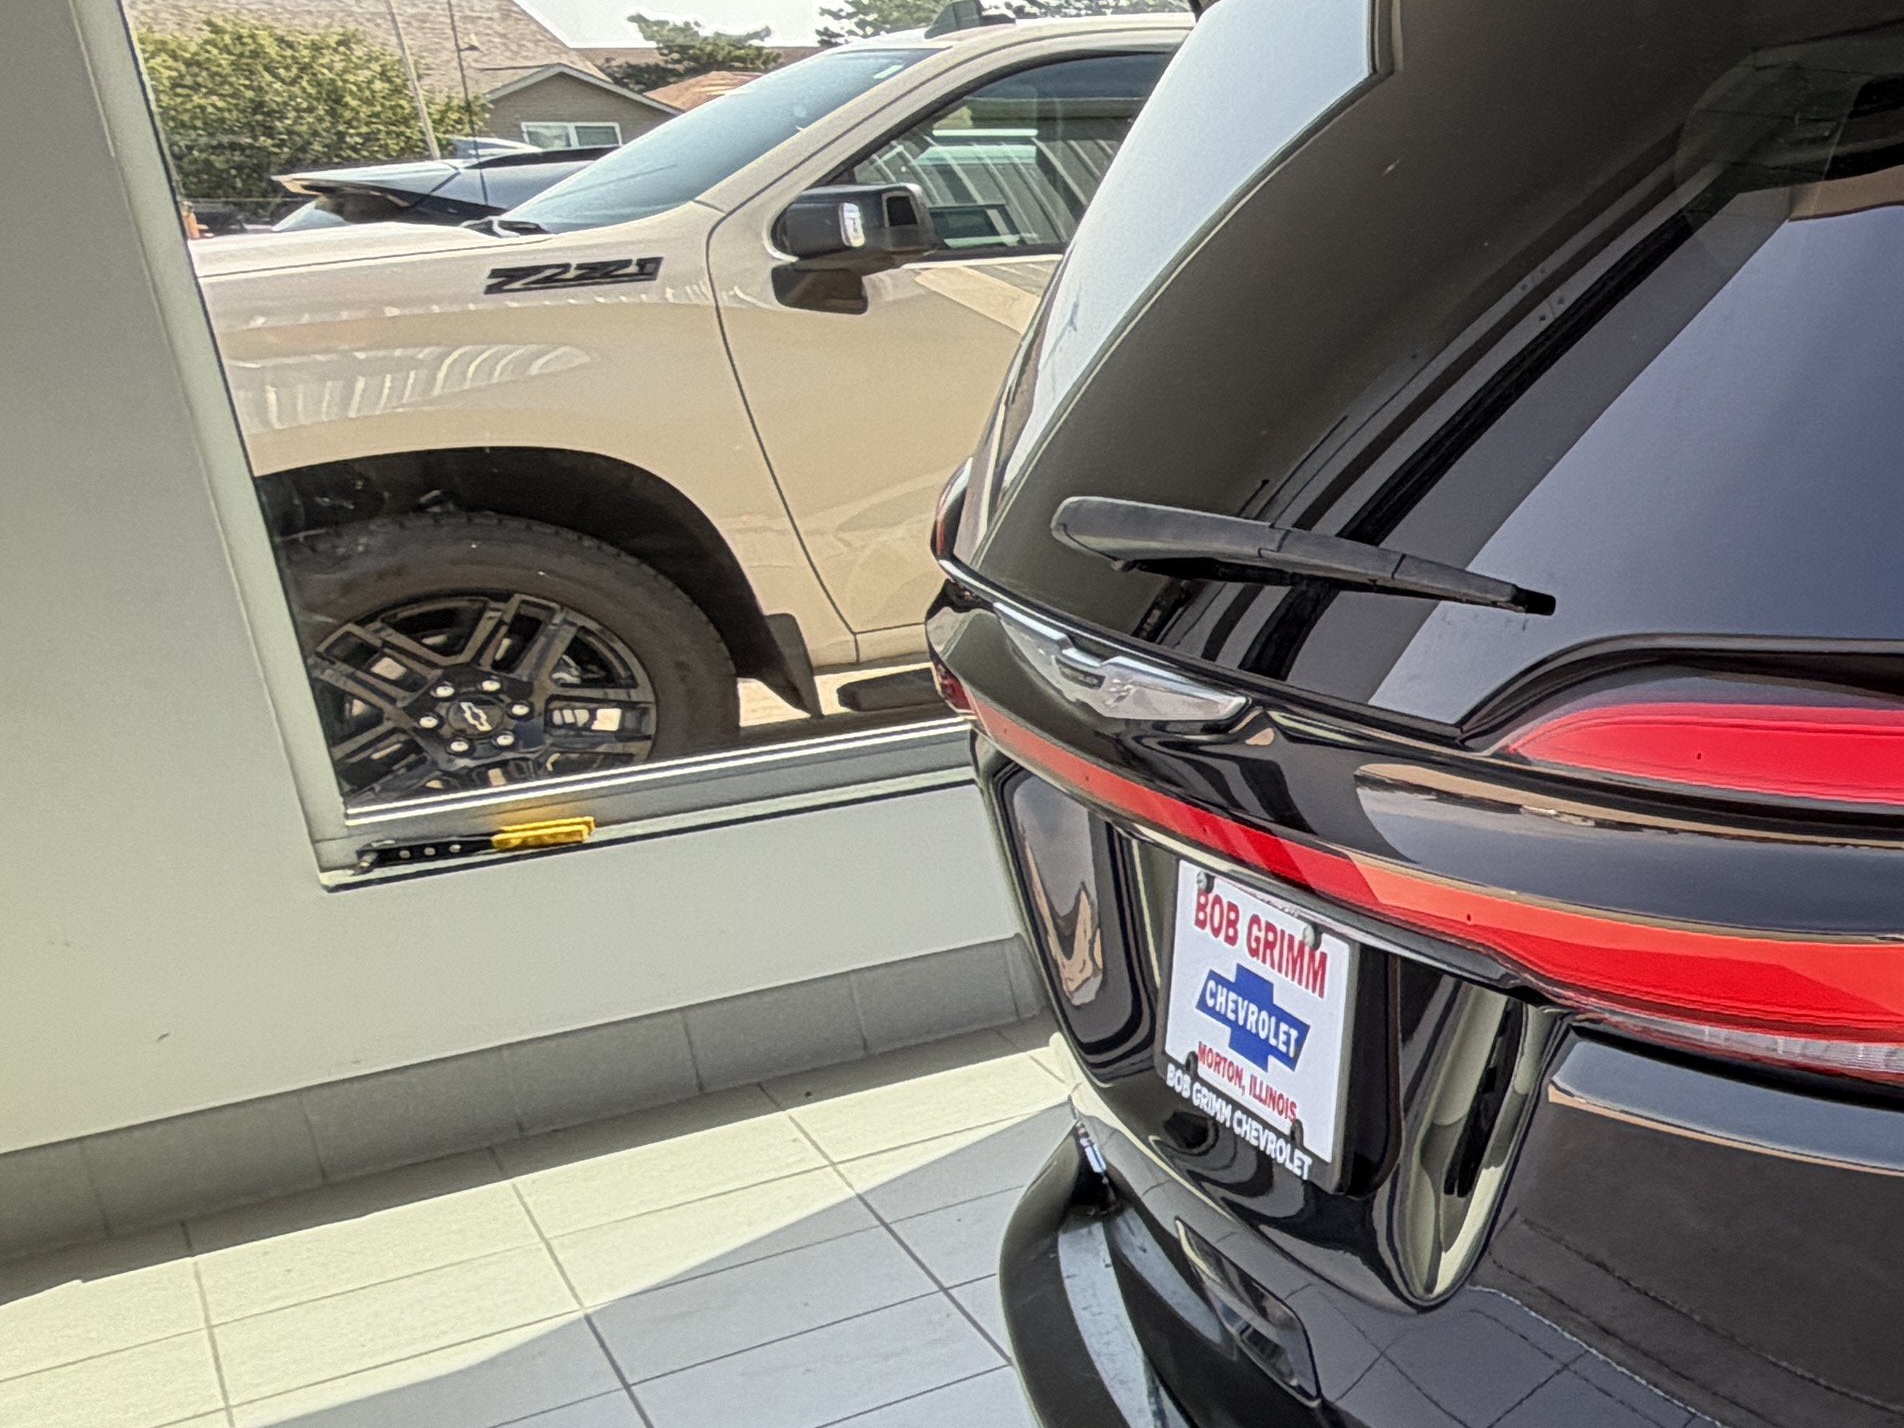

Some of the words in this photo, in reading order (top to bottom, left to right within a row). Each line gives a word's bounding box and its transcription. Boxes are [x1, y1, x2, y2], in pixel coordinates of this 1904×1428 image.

[1194, 891, 1240, 947] BOB
[1246, 913, 1328, 1000] GRIMM
[1205, 979, 1300, 1059] CHEVROLET
[1166, 1062, 1191, 1099] BOB
[1190, 1084, 1233, 1129] GRIMM
[1232, 1108, 1313, 1181] CHEVROLET
[1197, 1041, 1248, 1096] MORTON,
[1248, 1073, 1298, 1123] ILLINOIS
